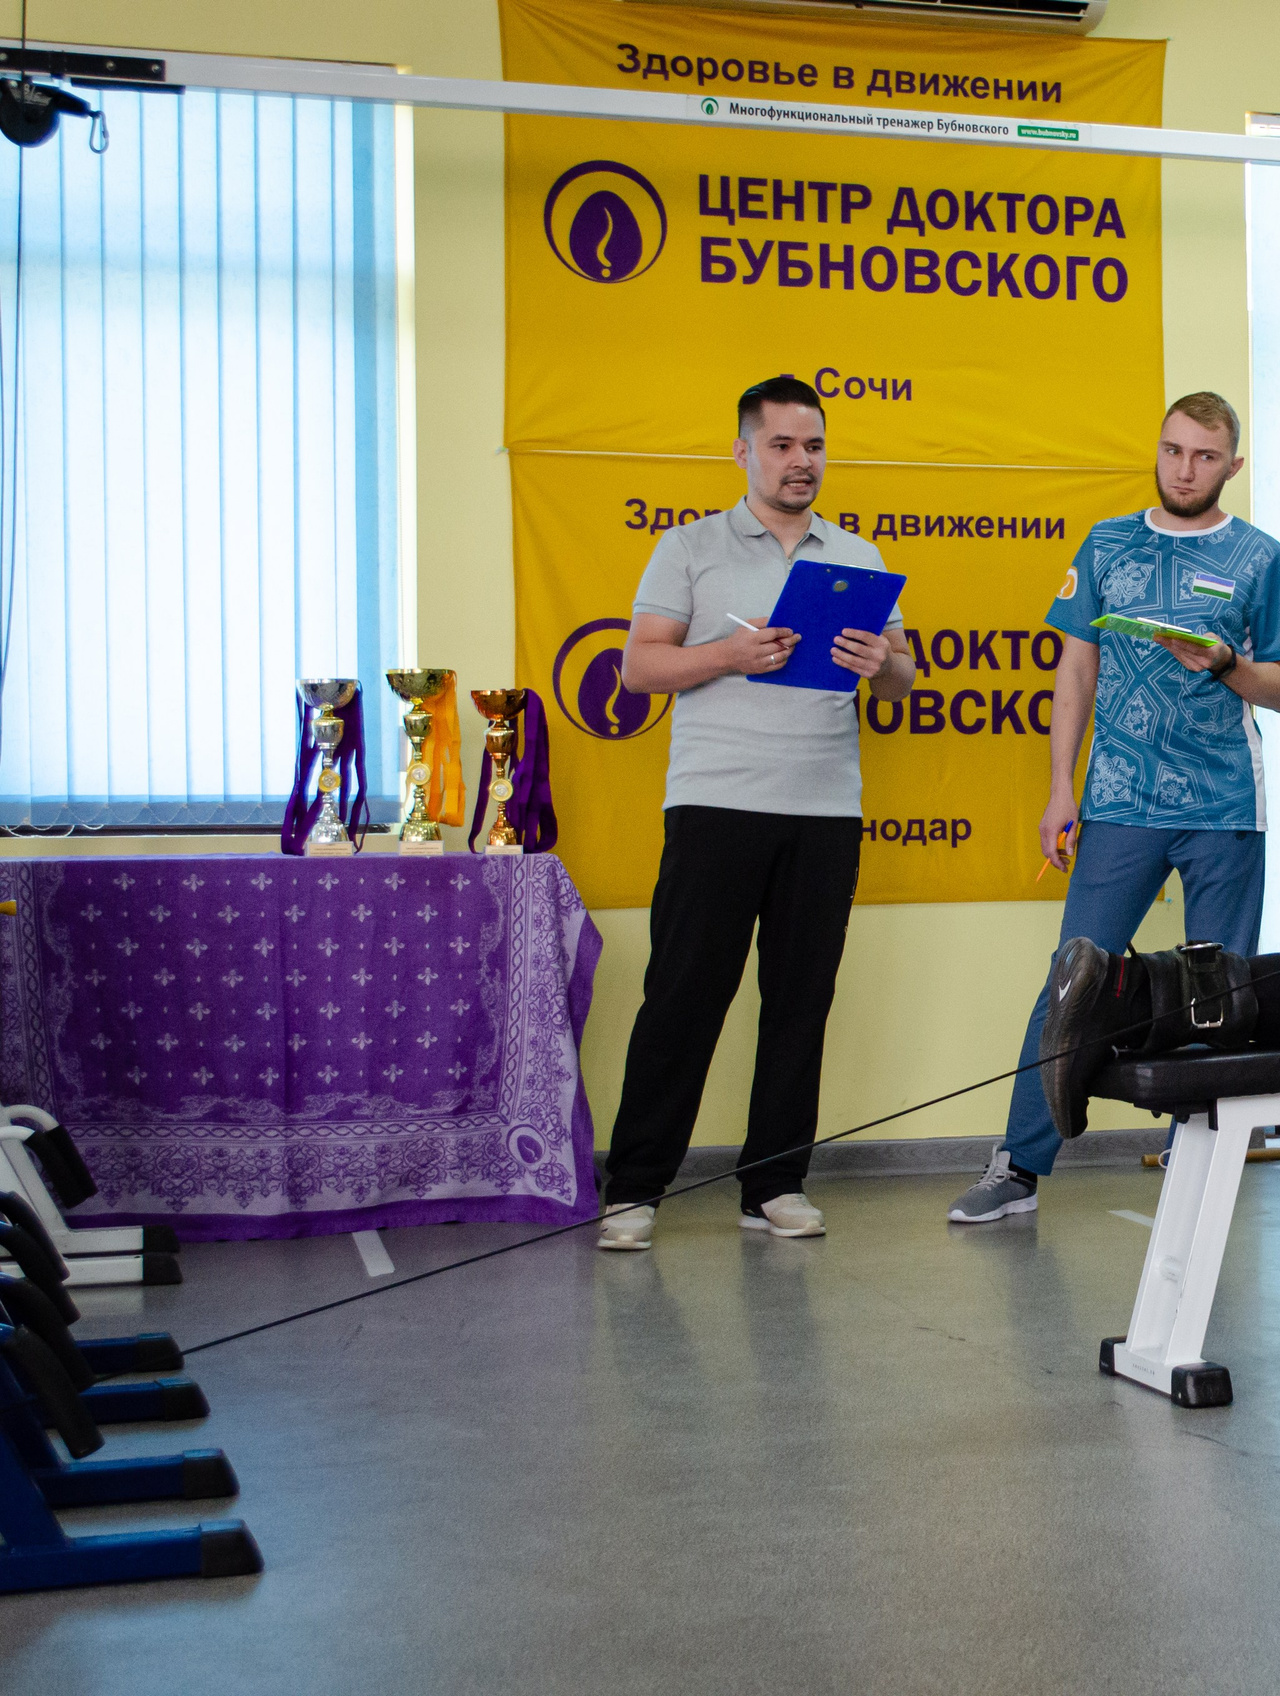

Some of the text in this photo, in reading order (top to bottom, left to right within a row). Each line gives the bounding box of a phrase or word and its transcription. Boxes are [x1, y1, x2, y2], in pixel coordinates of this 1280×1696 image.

[616, 43, 1062, 103] Здоровье в движении
[729, 102, 1009, 136] Многофункциональный тренажер Бубновского
[698, 174, 1127, 239] ЦЕНТР ДОКТОРА
[699, 236, 1129, 303] БУБНОВСКОГО
[814, 366, 912, 401] Сочи
[839, 512, 1065, 541] в движении
[905, 628, 1064, 678] ДОКТО
[861, 818, 972, 848] нодар
